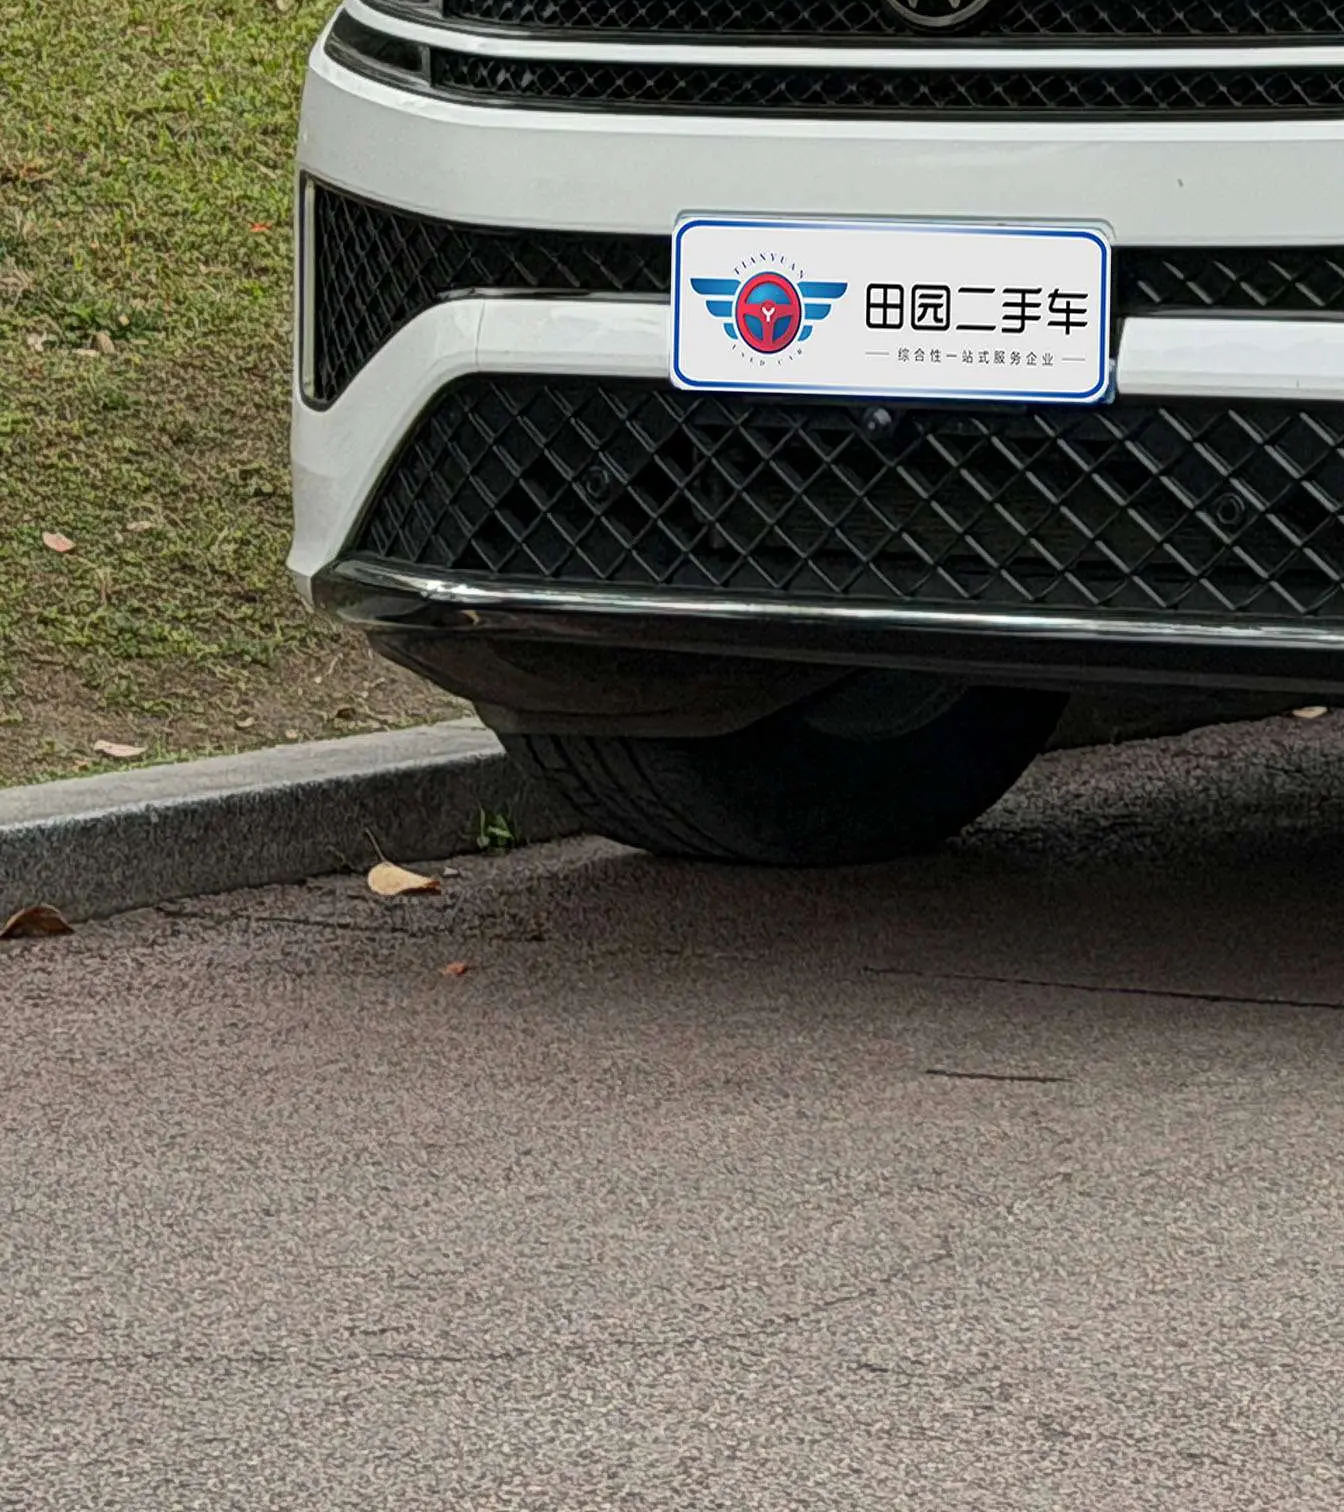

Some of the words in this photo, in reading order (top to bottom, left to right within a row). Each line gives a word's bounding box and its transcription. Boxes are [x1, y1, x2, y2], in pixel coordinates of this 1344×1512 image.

[866, 283, 1088, 335] 田园二手车
[897, 347, 1054, 367] 综合性一站式服务企业
